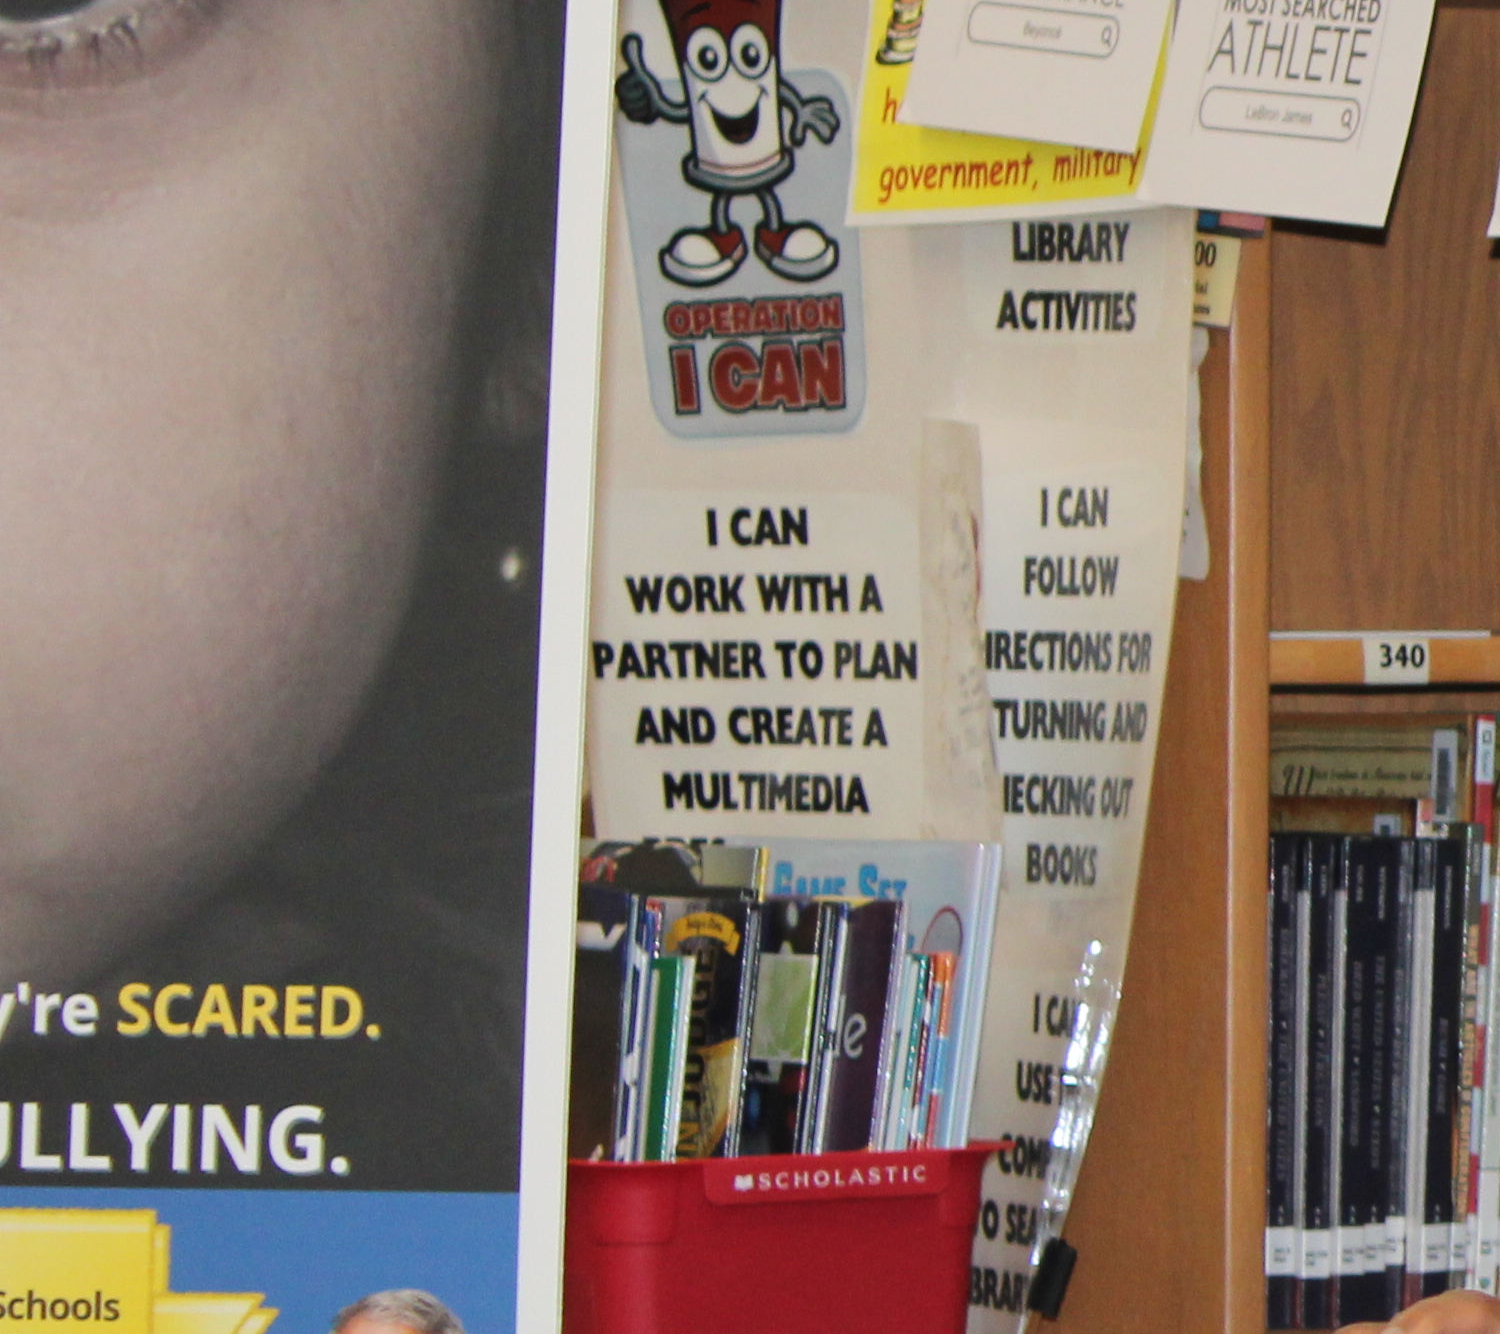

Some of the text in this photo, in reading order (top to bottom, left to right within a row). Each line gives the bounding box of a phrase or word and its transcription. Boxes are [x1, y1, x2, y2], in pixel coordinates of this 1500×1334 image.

[1206, 17, 1373, 87] ATHLETE
[877, 151, 1039, 204] government,
[1012, 220, 1131, 264] LIBRARY
[663, 291, 846, 340] OPERATION
[996, 289, 1137, 333] ACTIVITIES
[668, 333, 847, 415] I CAN
[706, 507, 809, 547] I CAN
[1056, 487, 1109, 529] CAN
[626, 573, 884, 614] WORK WITH A
[1023, 556, 1119, 597] FOLLOW
[593, 640, 918, 681] PARTNER TO PLAN
[1118, 631, 1152, 673] FOR
[1378, 640, 1426, 670] 340
[635, 707, 889, 747] AND CREATE A
[1110, 700, 1147, 743] AND
[663, 772, 870, 813] MULTIMEDIA
[1100, 777, 1134, 819] OUT
[1025, 843, 1098, 887] BOOKS
[116, 982, 382, 1040] SCARED.
[757, 1166, 929, 1192] SCHOLASTIC
